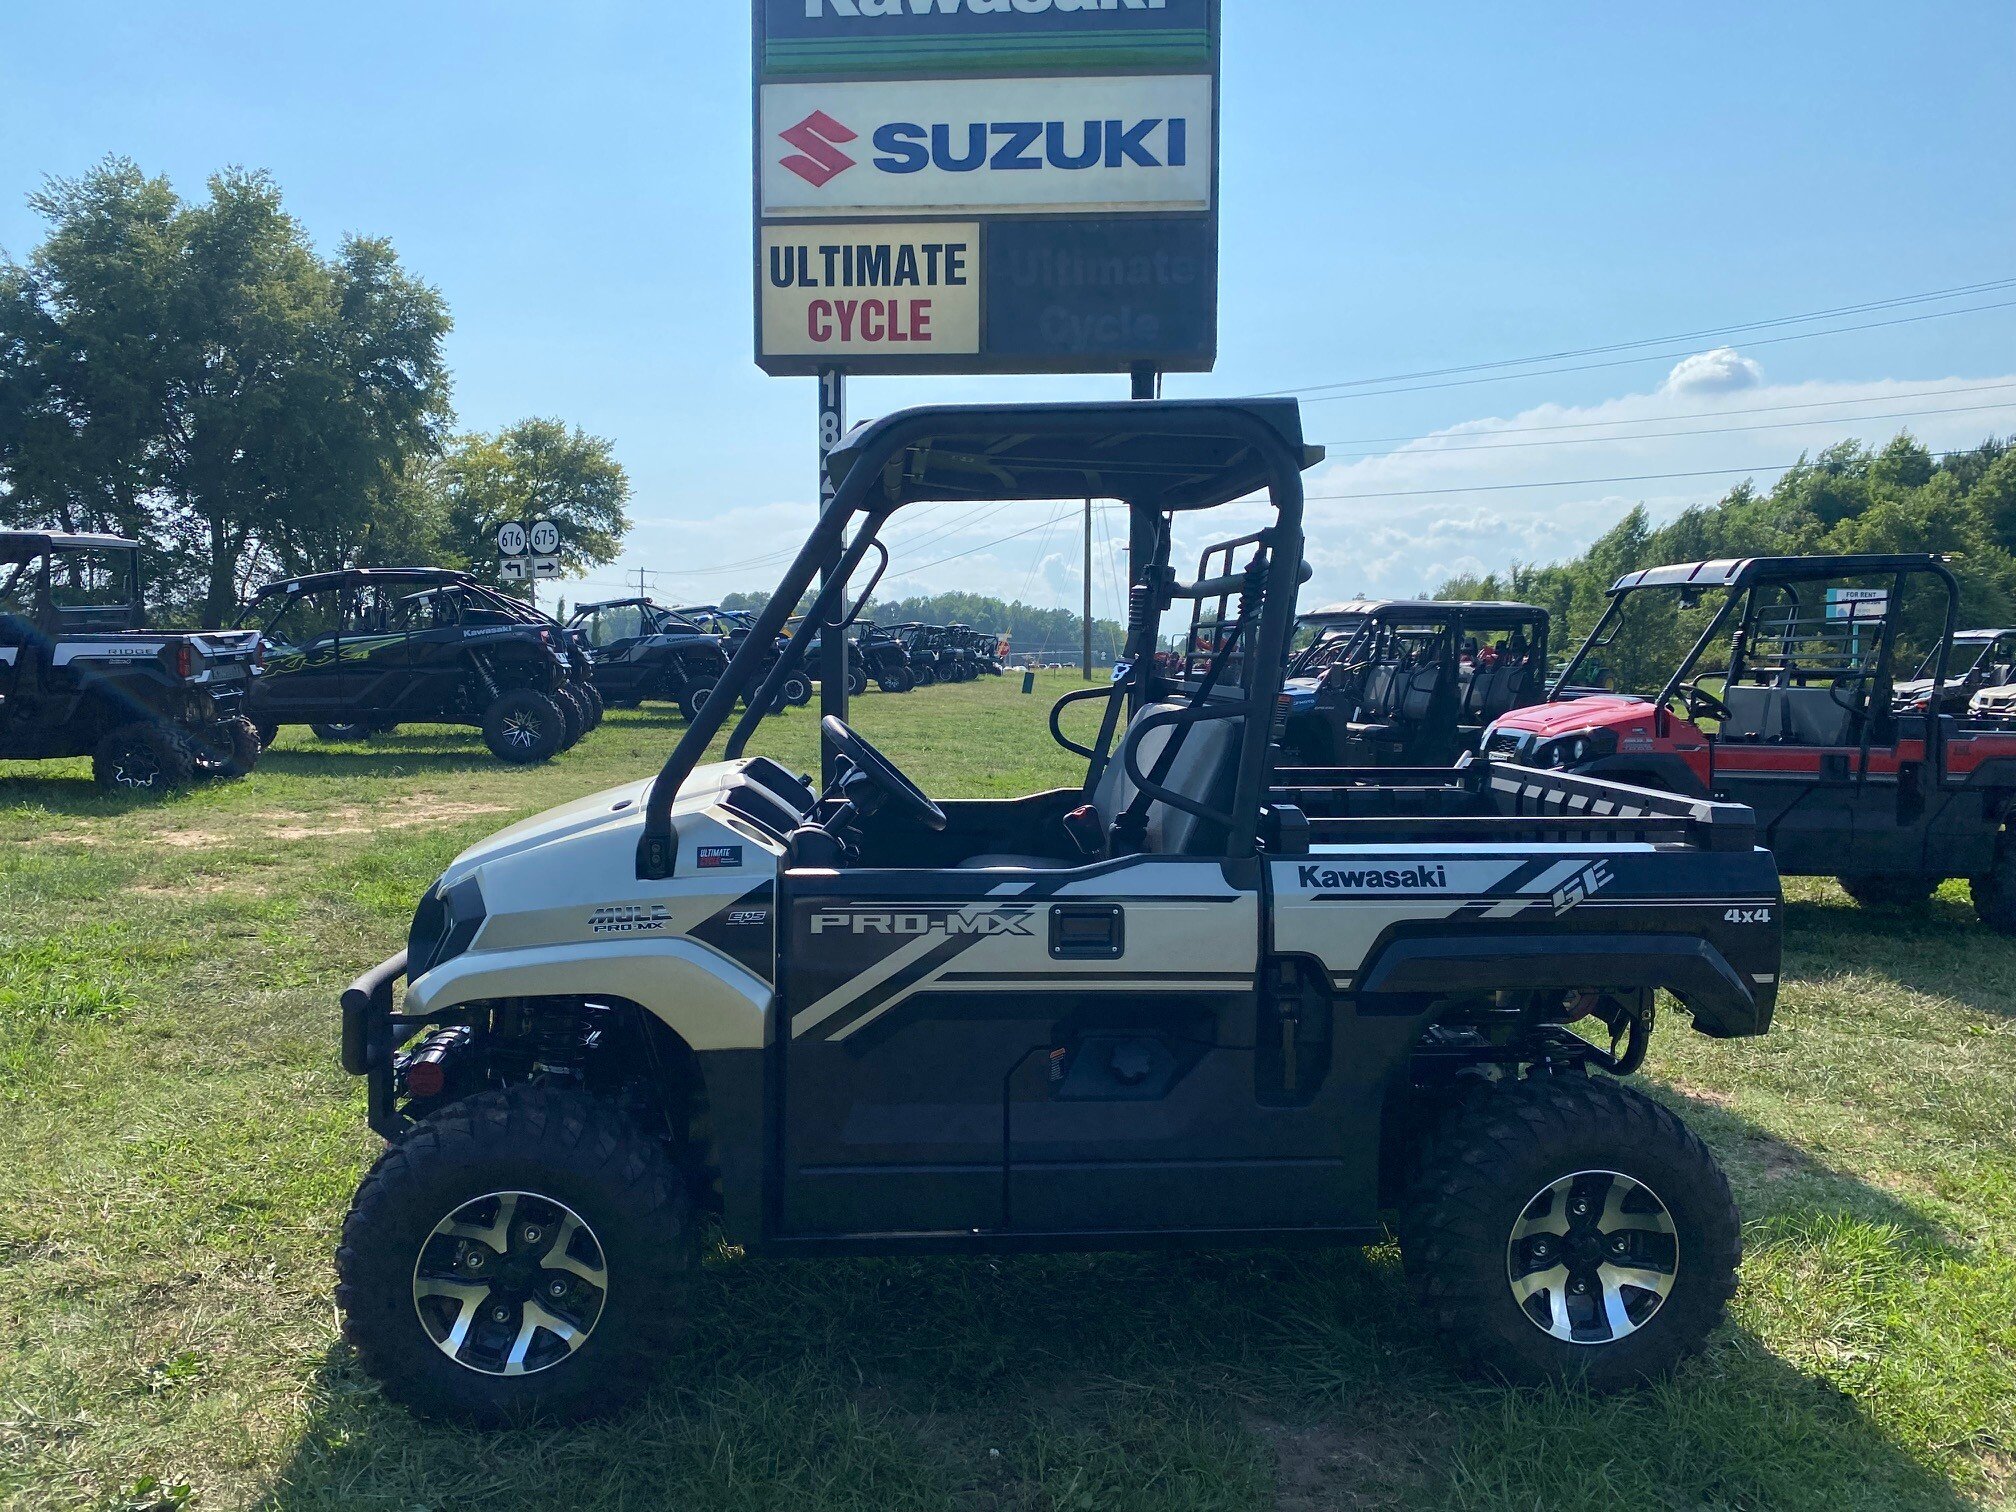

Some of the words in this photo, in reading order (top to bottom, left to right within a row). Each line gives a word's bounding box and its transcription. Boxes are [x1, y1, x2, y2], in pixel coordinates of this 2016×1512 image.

[872, 118, 1186, 174] SUZUKI
[770, 243, 967, 288] ULTIMATE
[807, 299, 932, 342] CYCLE
[501, 531, 522, 547] 676
[534, 529, 555, 545] 675
[462, 625, 512, 638] Kawasaki
[700, 848, 731, 858] ULTIMATE
[1297, 864, 1447, 888] Kawasaki
[1552, 858, 1615, 918] SE
[587, 904, 674, 925] MULE
[810, 911, 1037, 936] PRO-MX
[1723, 908, 1771, 923] 4x4
[593, 921, 667, 934] PRO-MX
